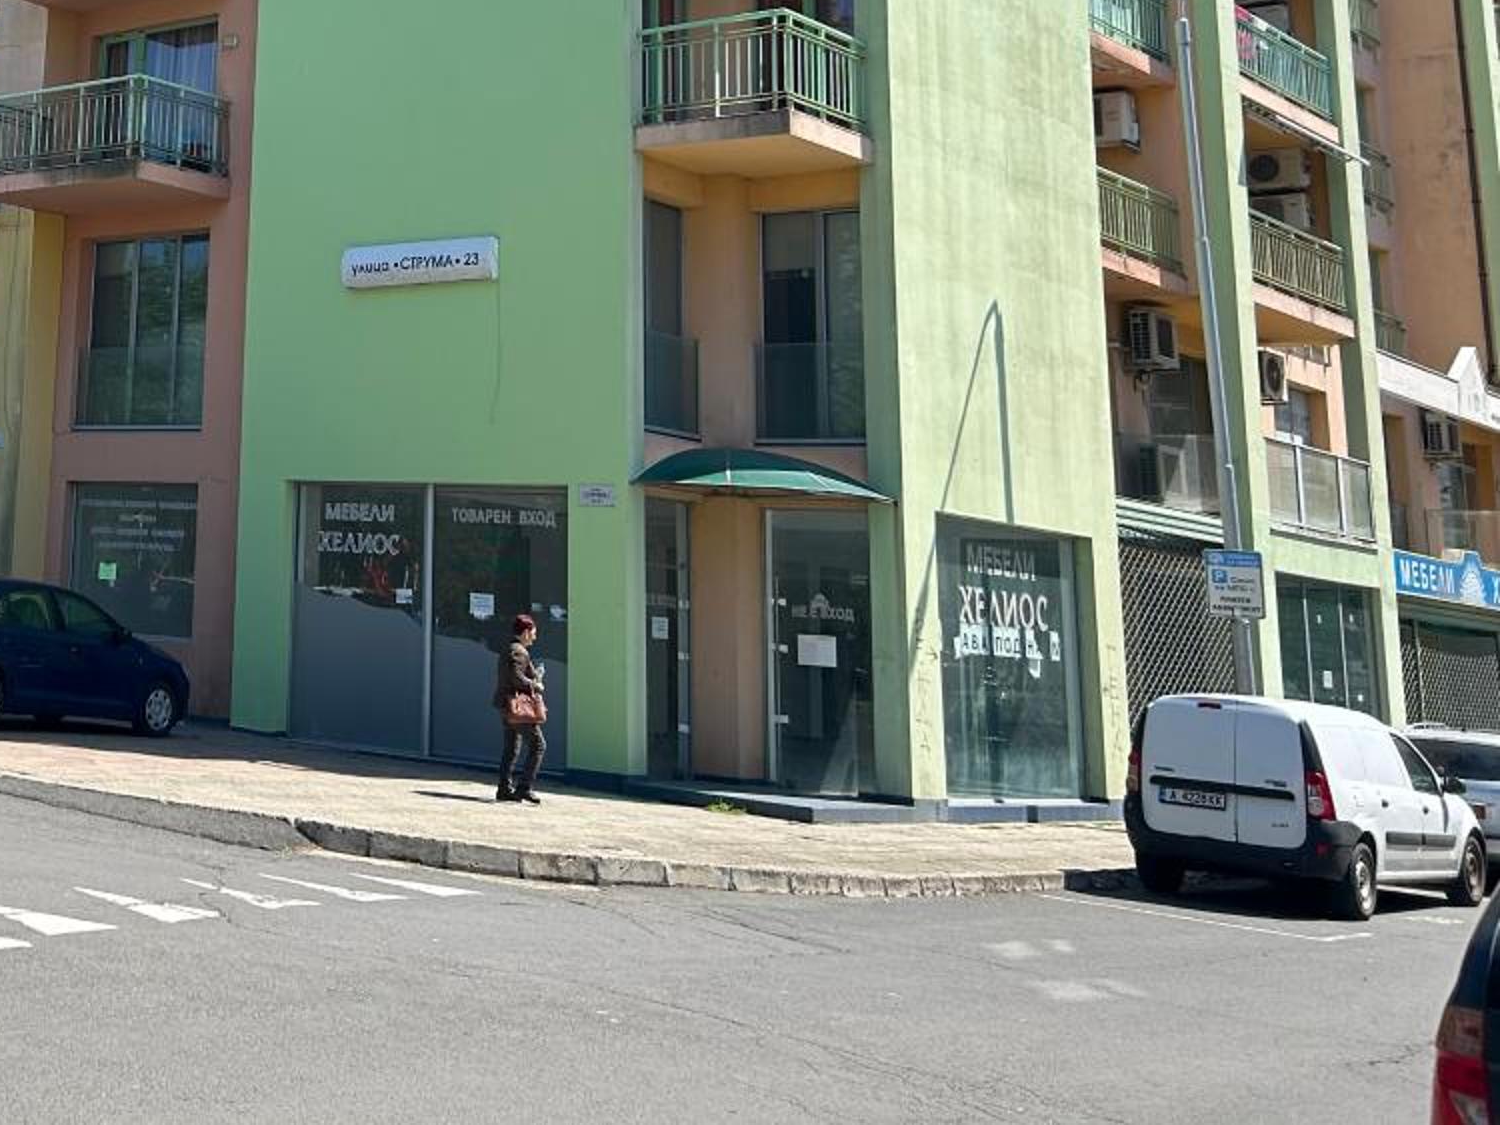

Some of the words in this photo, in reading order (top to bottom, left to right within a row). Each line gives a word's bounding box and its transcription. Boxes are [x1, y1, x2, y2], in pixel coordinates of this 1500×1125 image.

[351, 262, 389, 276] улица
[400, 254, 453, 270] СТРУМА
[463, 252, 479, 266] 23
[325, 502, 395, 522] МЕБЕЛИ
[452, 507, 511, 524] ТОВАРЕН
[519, 509, 556, 528] ВХОД
[317, 530, 400, 556] ХЕЛИОС
[966, 542, 1037, 581] МЕБЕЛИ
[1399, 558, 1455, 594] МЕБЕЛИ
[958, 585, 1048, 632] ХЕЛИОС
